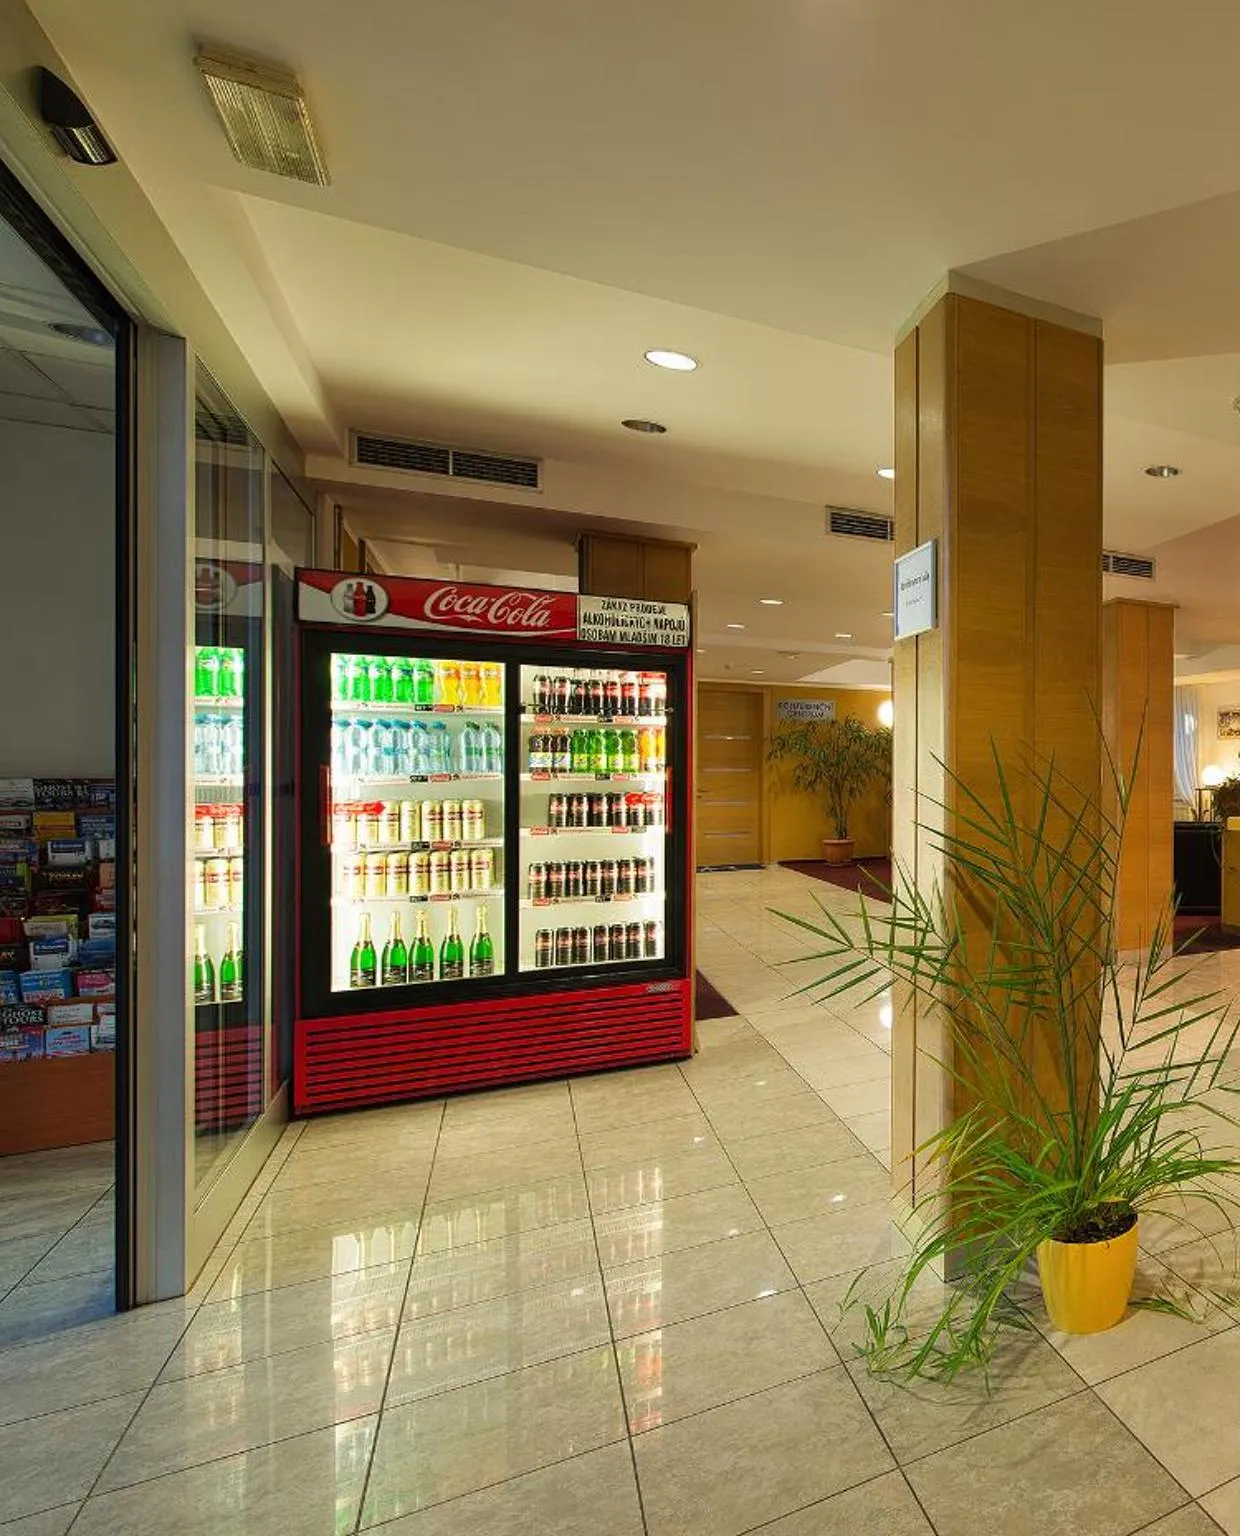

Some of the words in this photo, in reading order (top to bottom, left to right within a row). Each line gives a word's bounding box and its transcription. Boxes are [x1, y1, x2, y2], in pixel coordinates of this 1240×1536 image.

[424, 586, 556, 627] Coca-Cola
[660, 634, 670, 645] 18
[672, 634, 686, 646] LET
